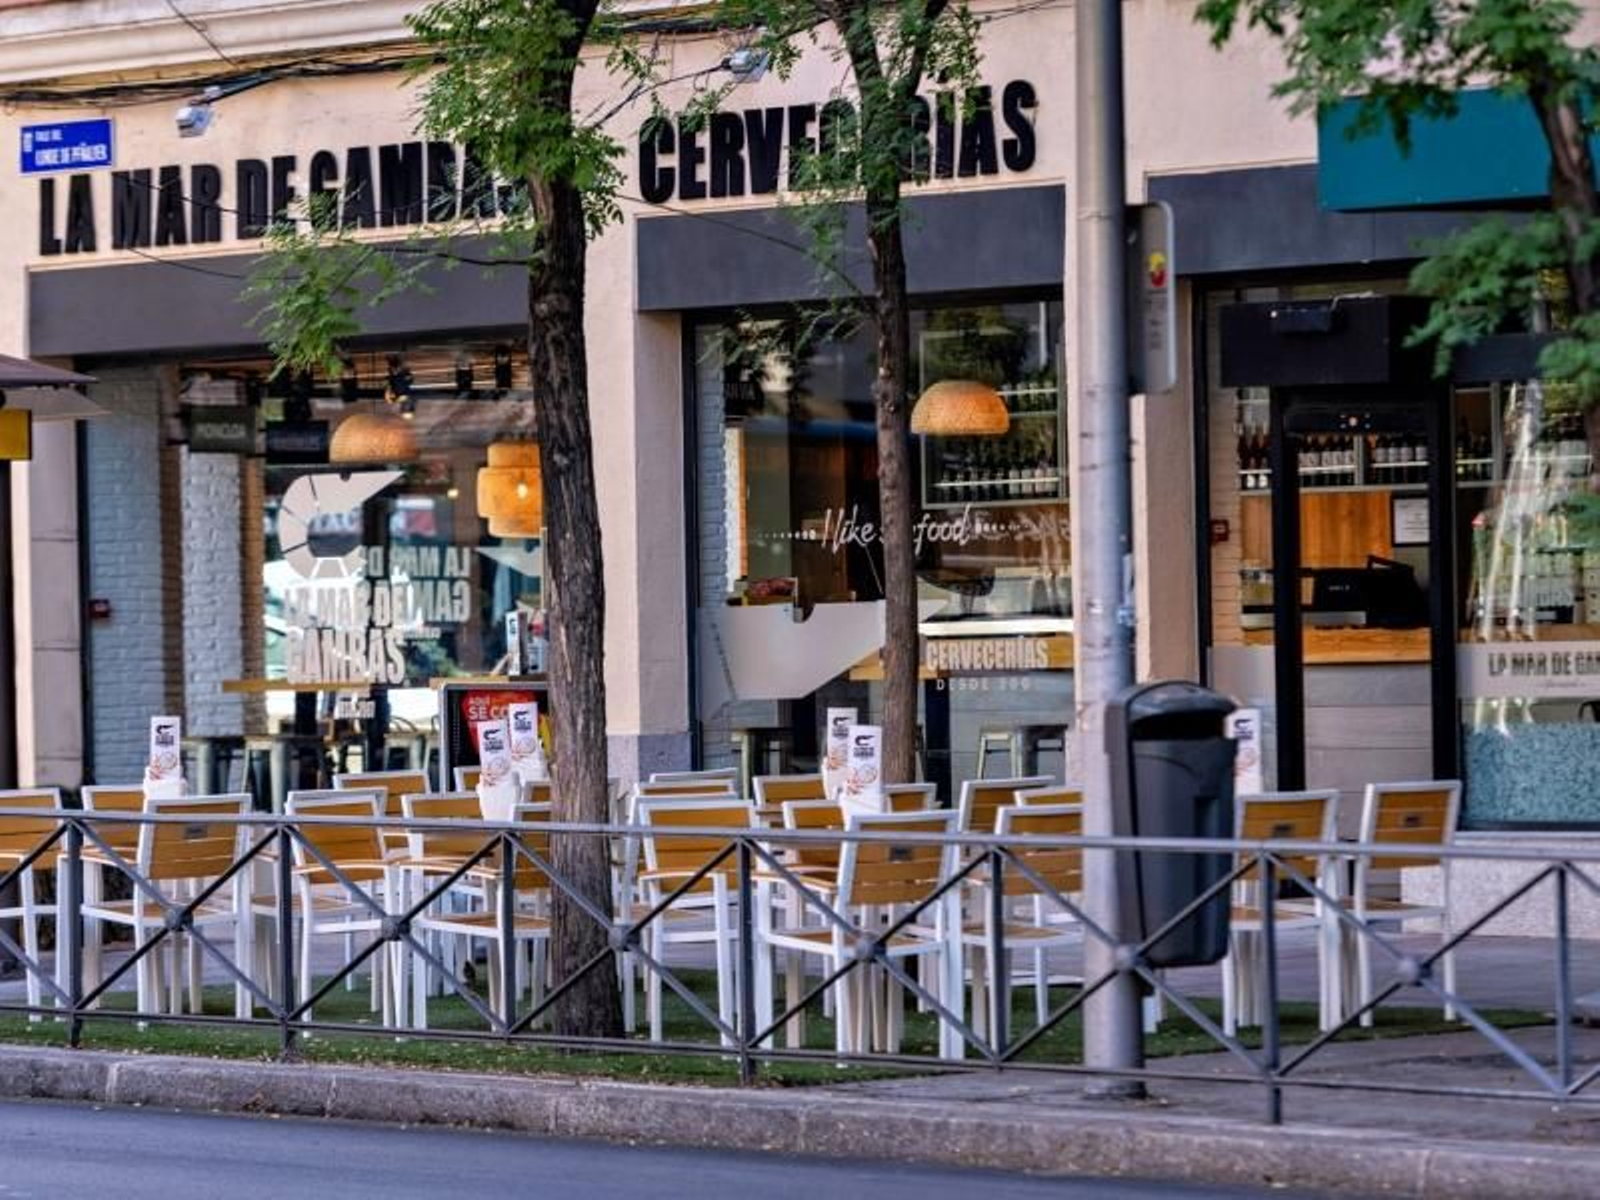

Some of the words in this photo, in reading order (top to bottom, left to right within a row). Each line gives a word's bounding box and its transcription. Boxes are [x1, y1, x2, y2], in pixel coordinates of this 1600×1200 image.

[638, 78, 1038, 204] CERVECRÍAS
[39, 174, 97, 256] LA
[111, 164, 222, 250] MAR
[236, 155, 298, 240] DE
[287, 627, 405, 684] GAMBAS
[926, 635, 1048, 671] CERVECERÍAS
[1551, 652, 1571, 675] DE
